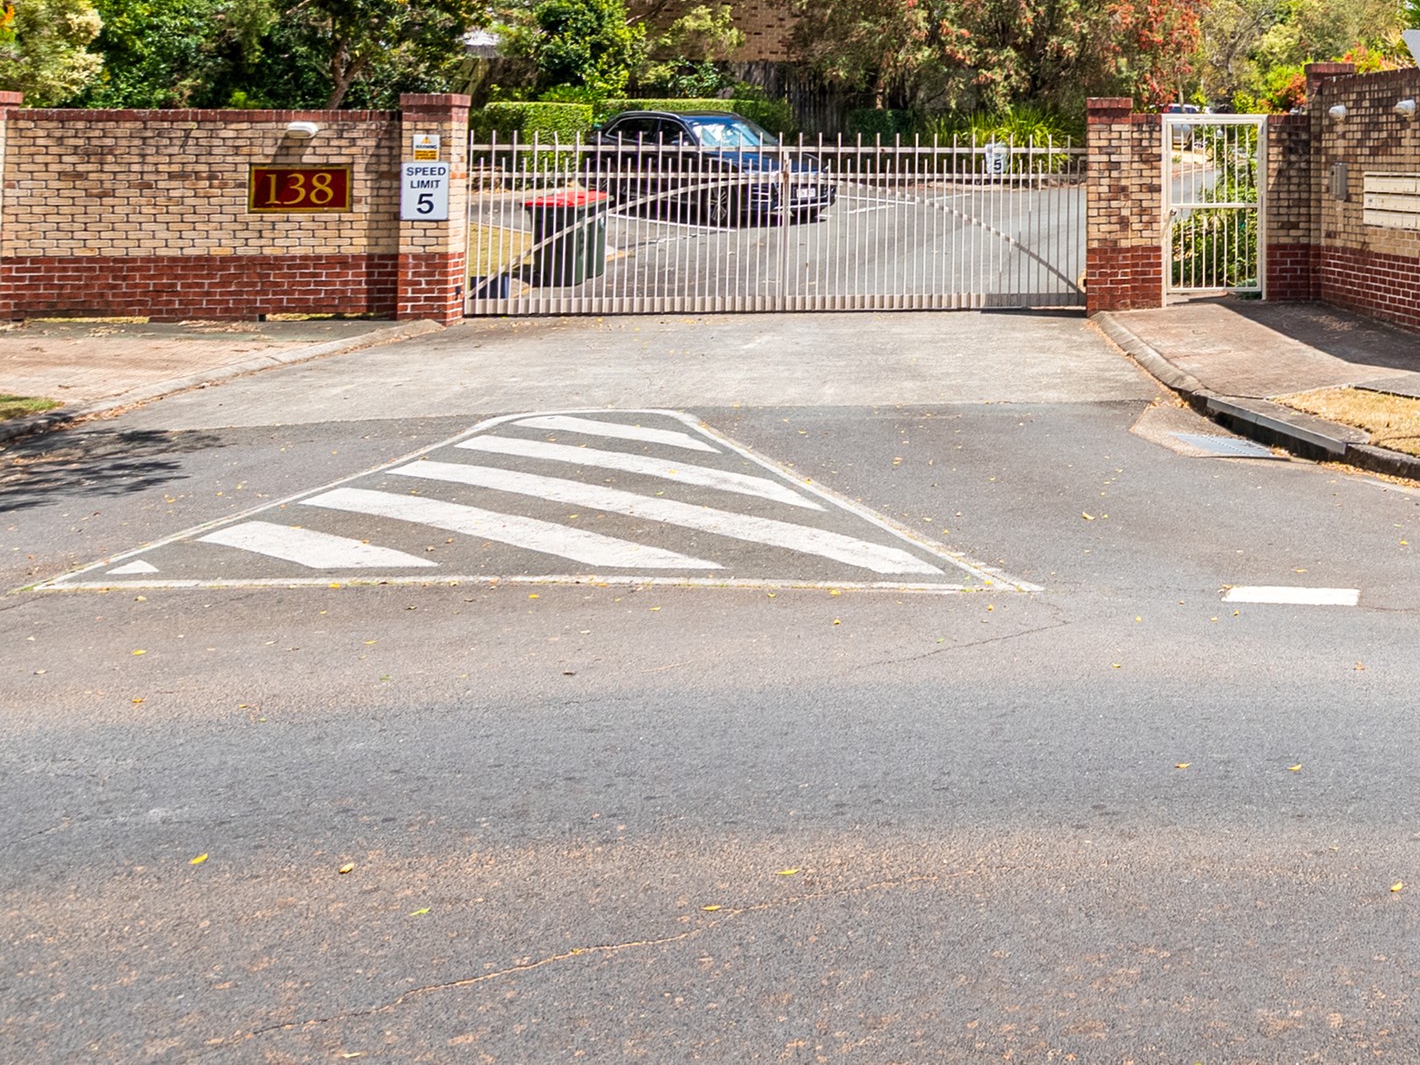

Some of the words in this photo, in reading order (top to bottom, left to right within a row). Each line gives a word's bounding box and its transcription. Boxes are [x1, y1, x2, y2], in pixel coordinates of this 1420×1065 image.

[993, 158, 1002, 171] 5
[406, 166, 447, 177] SPEED
[265, 172, 334, 205] 138
[410, 179, 441, 189] LIMIT
[416, 193, 434, 215] 5
